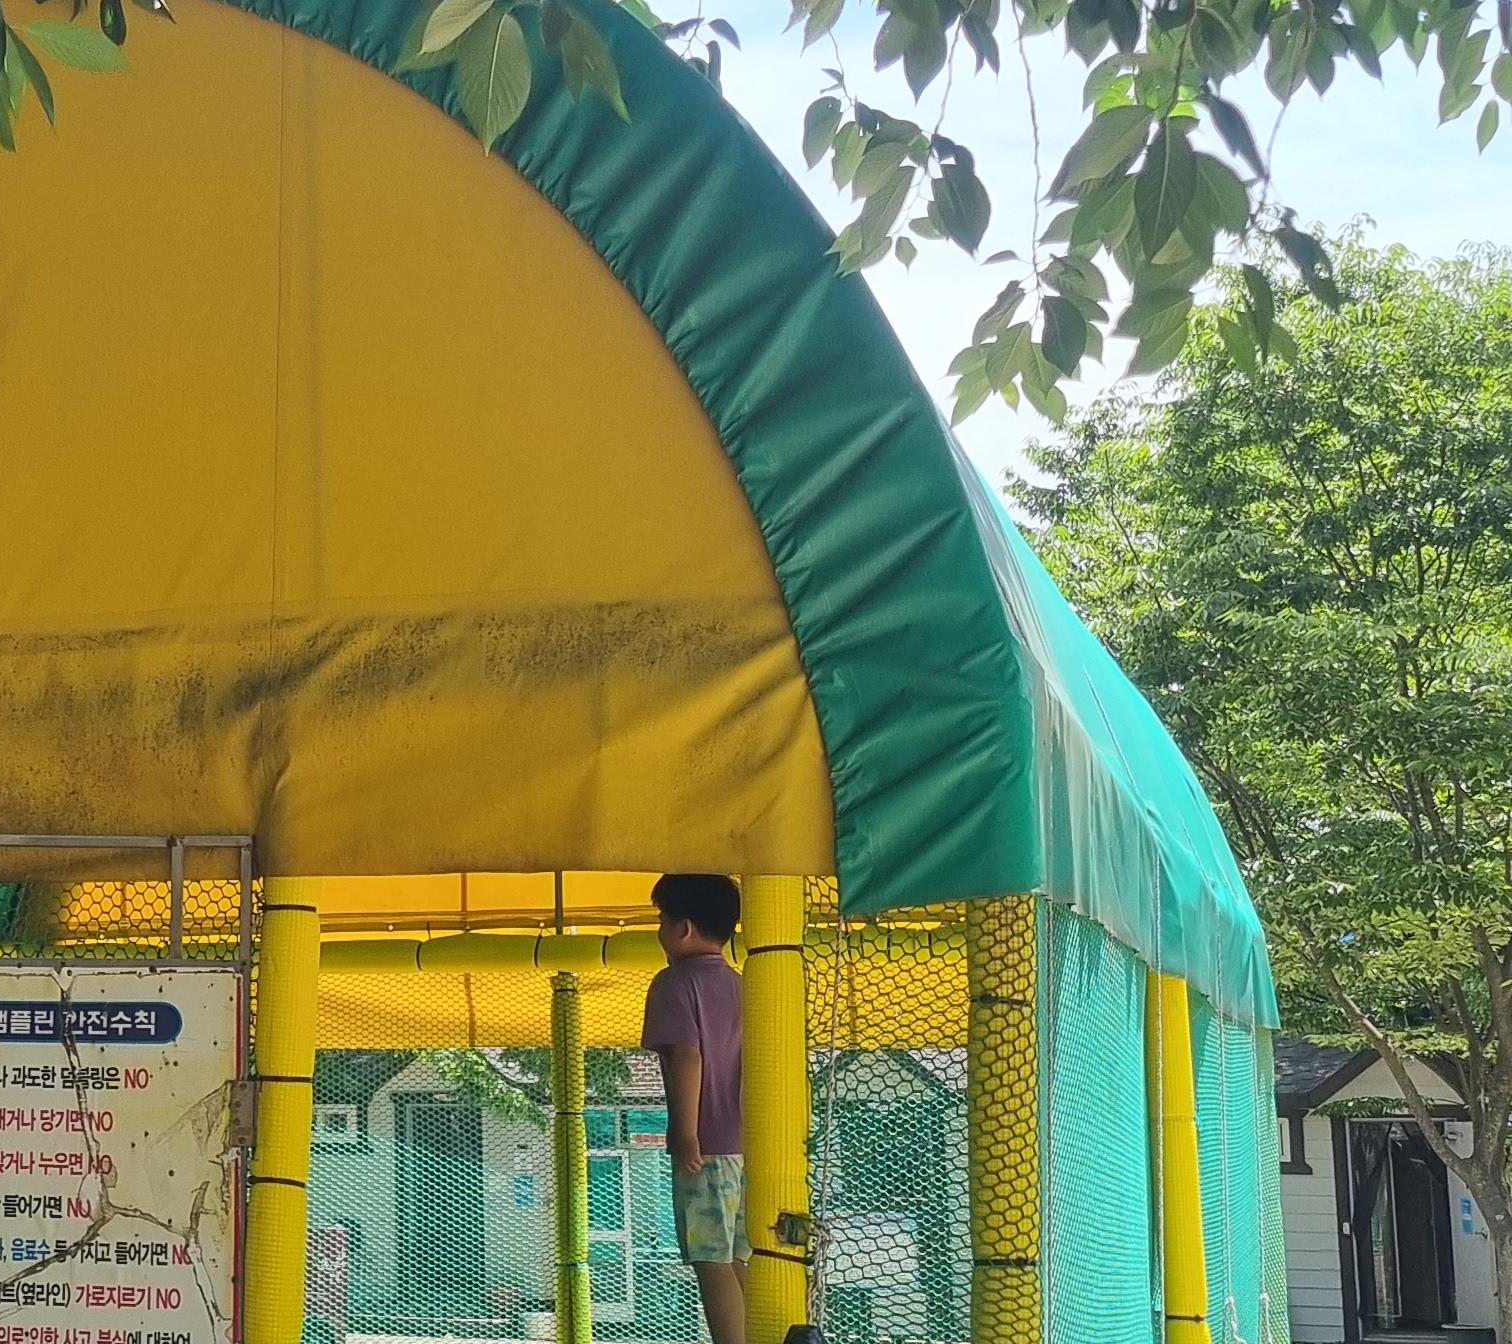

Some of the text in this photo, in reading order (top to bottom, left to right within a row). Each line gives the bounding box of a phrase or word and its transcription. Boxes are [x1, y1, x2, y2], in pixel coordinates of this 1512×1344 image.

[11, 1066, 56, 1089] 과도한
[124, 1068, 149, 1089] NO
[40, 1109, 87, 1132] 당기면
[90, 1111, 113, 1132] NO
[38, 1152, 83, 1175] 누우면
[89, 1154, 112, 1175] NO
[2, 1195, 62, 1219] 들어가면
[10, 1238, 51, 1261] 음료수
[114, 1242, 168, 1265] 들어가면
[75, 1284, 152, 1310] 가로지르기
[156, 1287, 181, 1309] NO
